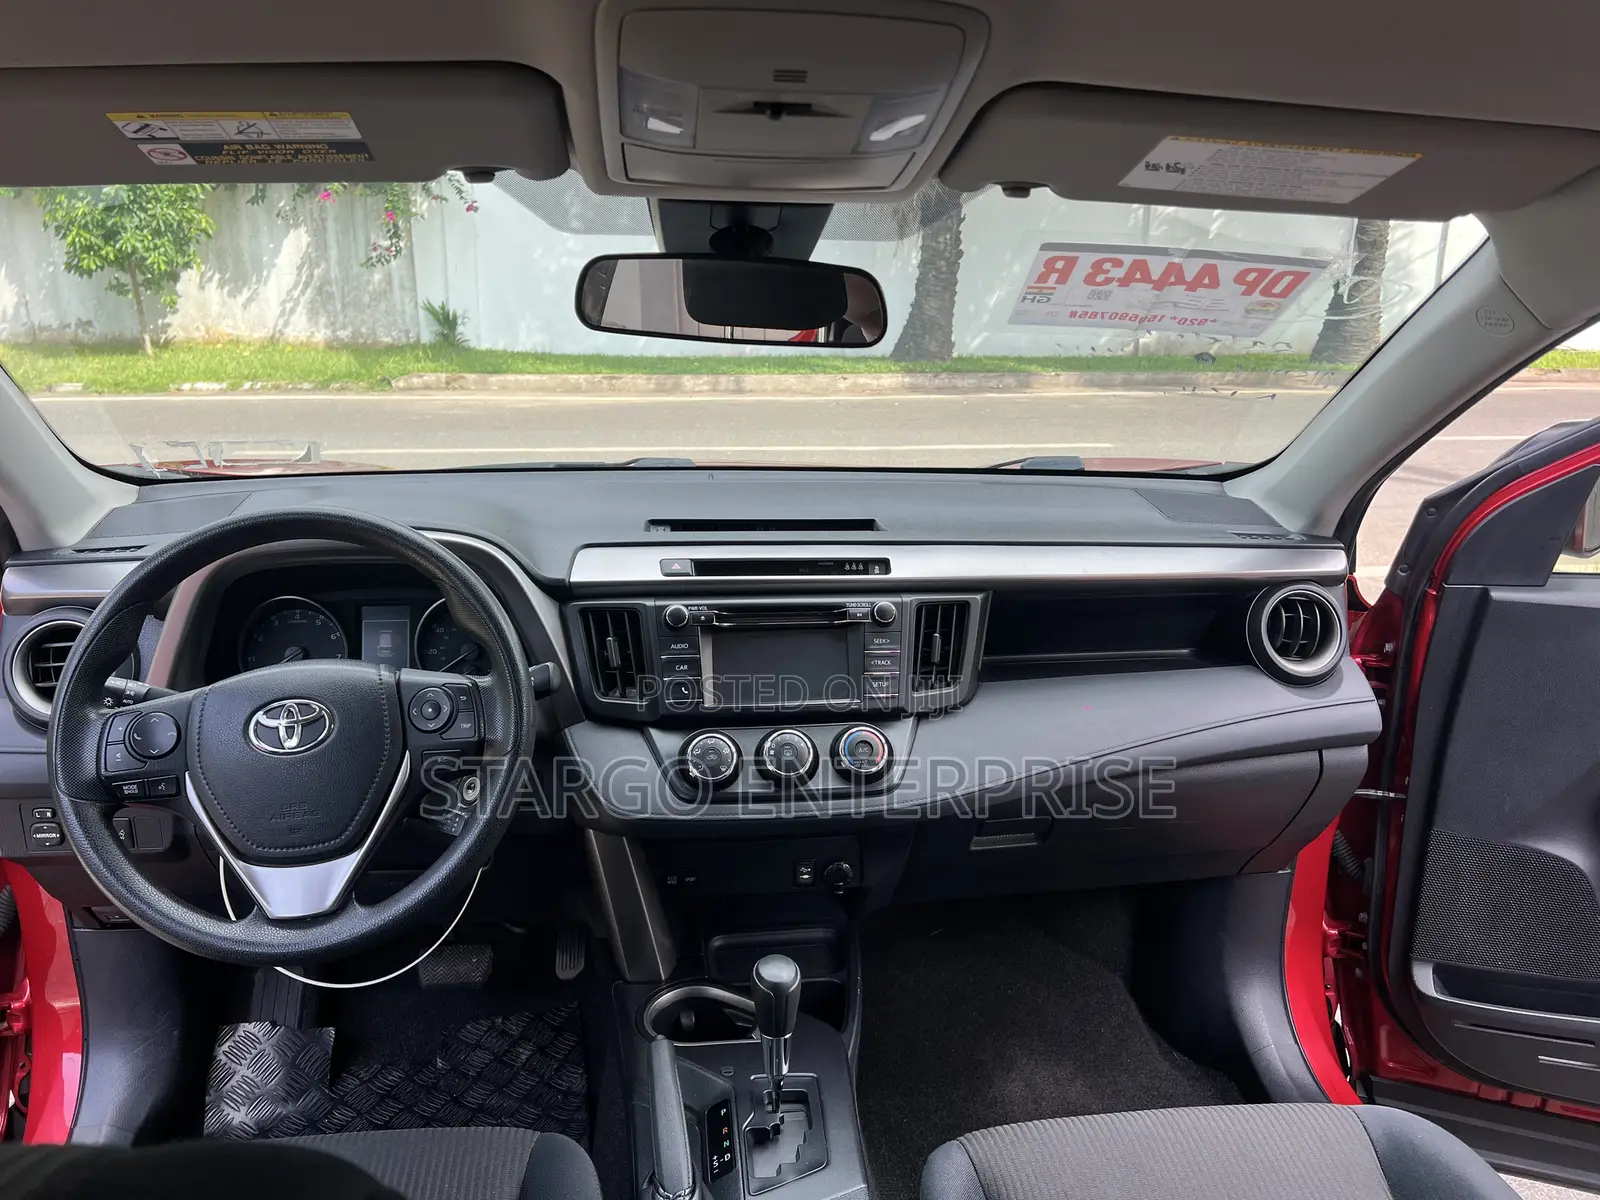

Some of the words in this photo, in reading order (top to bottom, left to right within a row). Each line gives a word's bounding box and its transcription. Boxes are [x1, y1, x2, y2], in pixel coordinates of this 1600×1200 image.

[273, 143, 329, 151] WARNING
[720, 1108, 727, 1116] P
[722, 1127, 729, 1135] R
[723, 1140, 730, 1148] N
[724, 1153, 731, 1162] D
